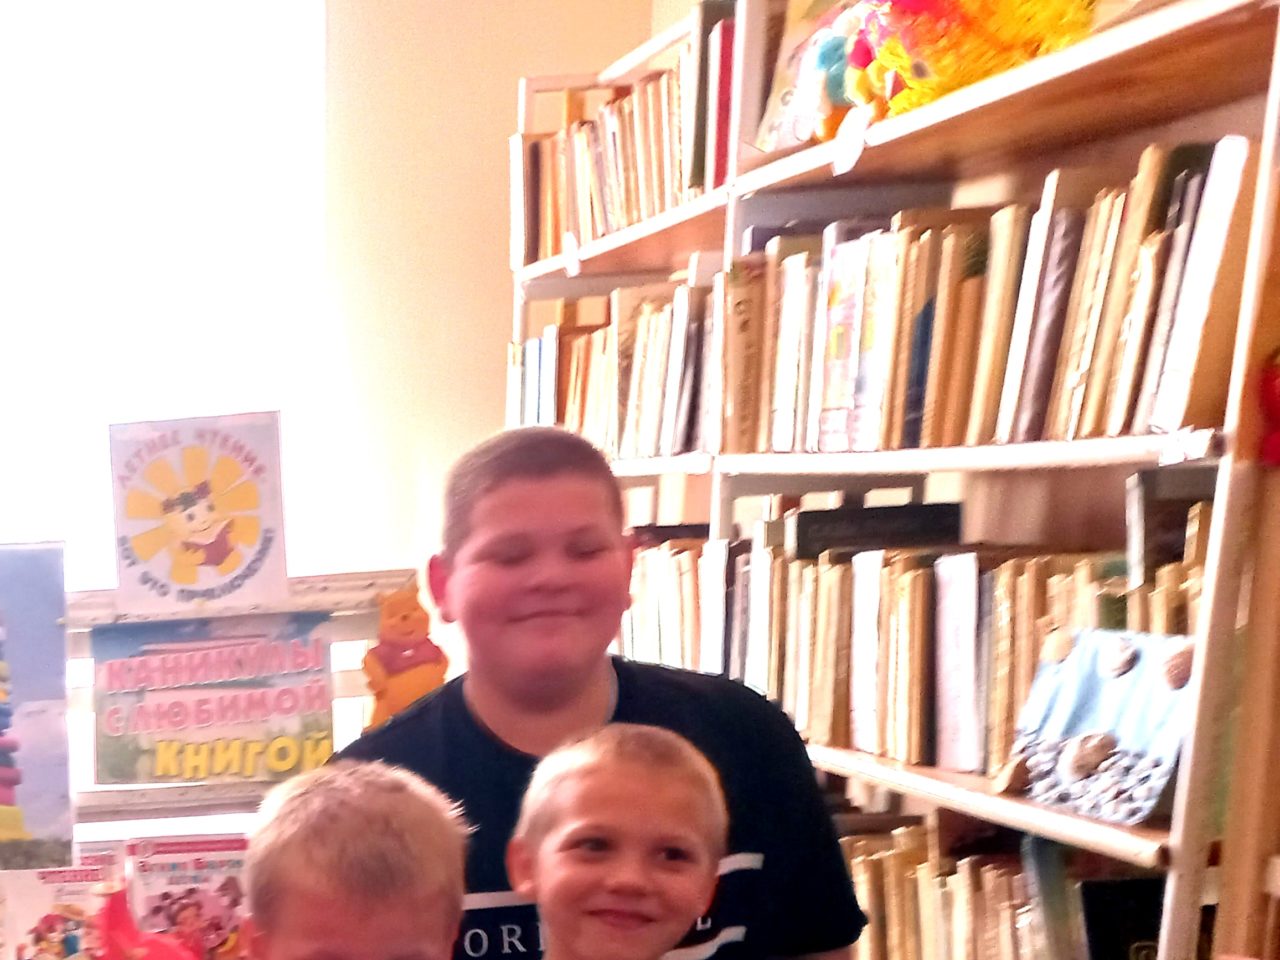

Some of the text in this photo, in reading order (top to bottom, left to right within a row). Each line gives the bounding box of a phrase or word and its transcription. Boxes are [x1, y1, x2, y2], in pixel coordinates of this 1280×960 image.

[104, 636, 326, 693] КАНИКУЛЫ
[105, 676, 331, 737] С ЛЮБИМОЙ
[153, 729, 333, 780] КНИГОЙ
